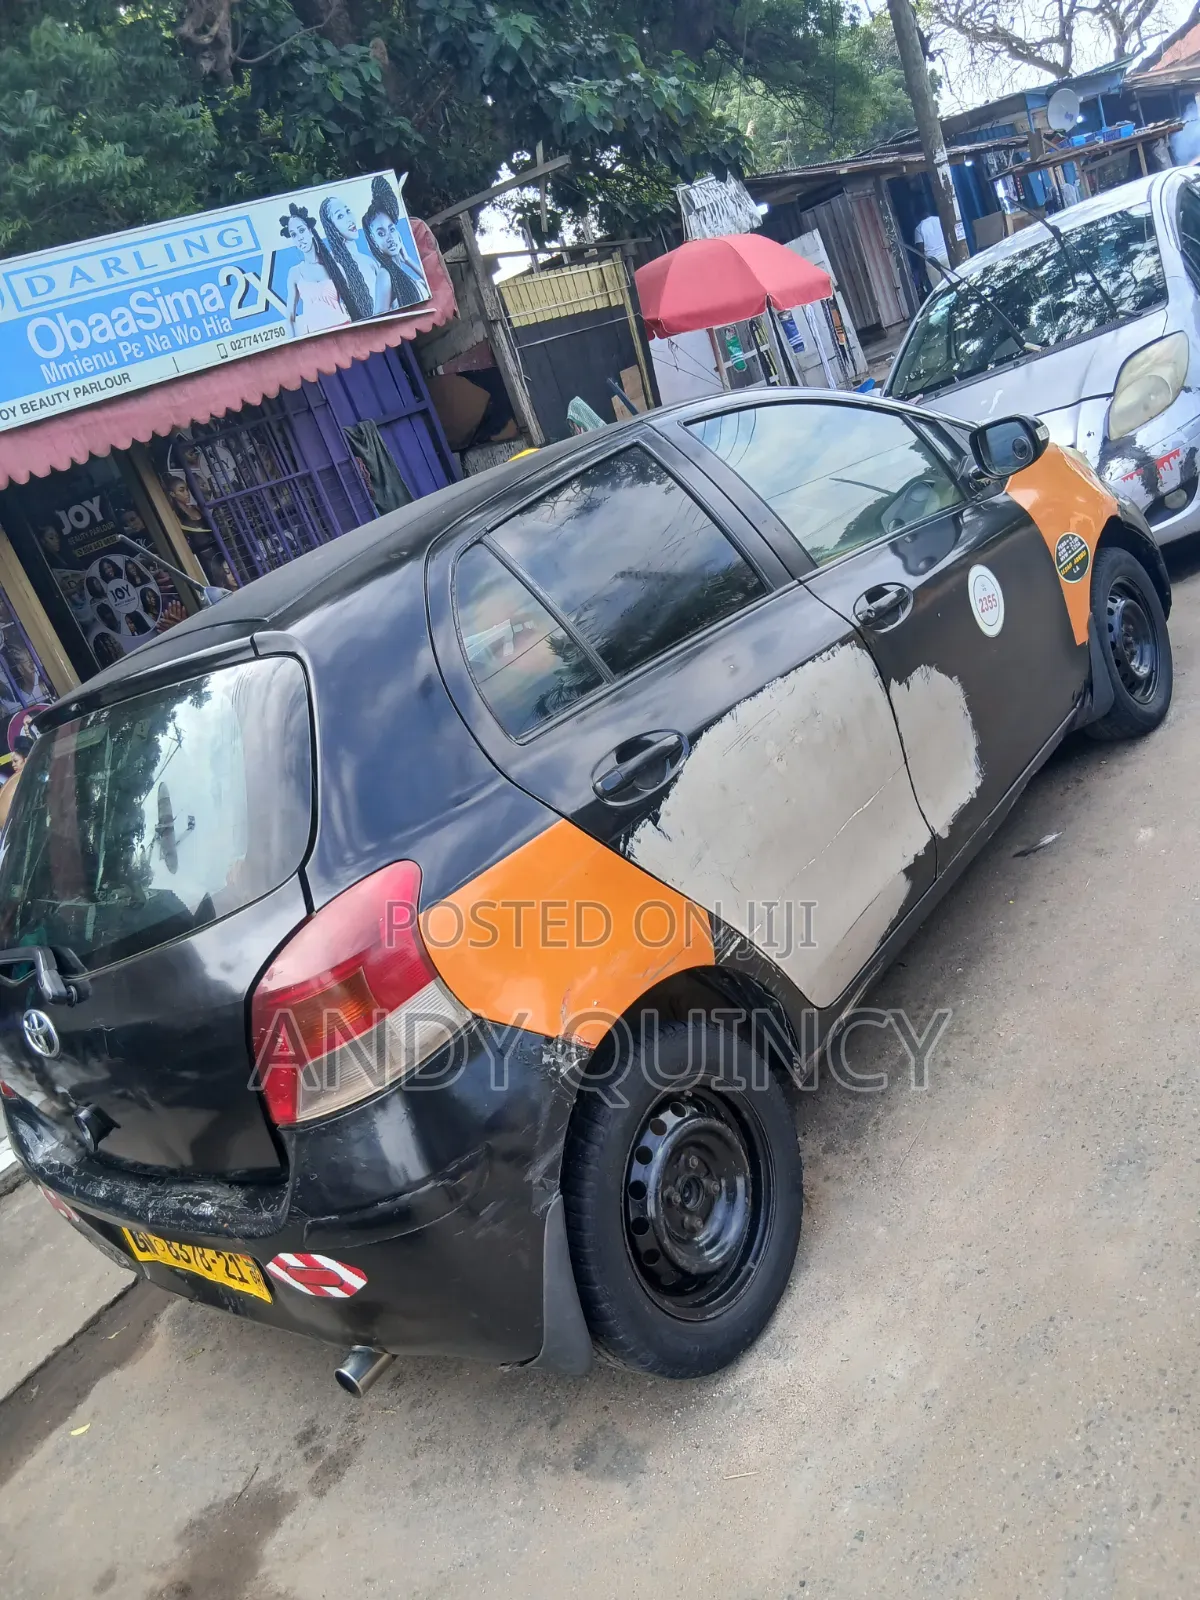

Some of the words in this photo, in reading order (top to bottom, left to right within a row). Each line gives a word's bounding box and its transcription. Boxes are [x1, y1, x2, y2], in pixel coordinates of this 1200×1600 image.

[24, 227, 244, 298] DARLING
[26, 282, 226, 359] ObaaSima
[230, 326, 286, 351] 0277412750
[40, 349, 118, 385] Mmienu
[146, 331, 173, 355] Na
[170, 323, 202, 346] Wo
[201, 315, 233, 337] Hia
[20, 390, 70, 415] BEAUTY
[73, 372, 132, 399] PARLOUR
[55, 494, 104, 536] JOY
[89, 520, 116, 537] PARLOUR
[110, 584, 131, 603] JOY
[978, 593, 998, 613] 2355
